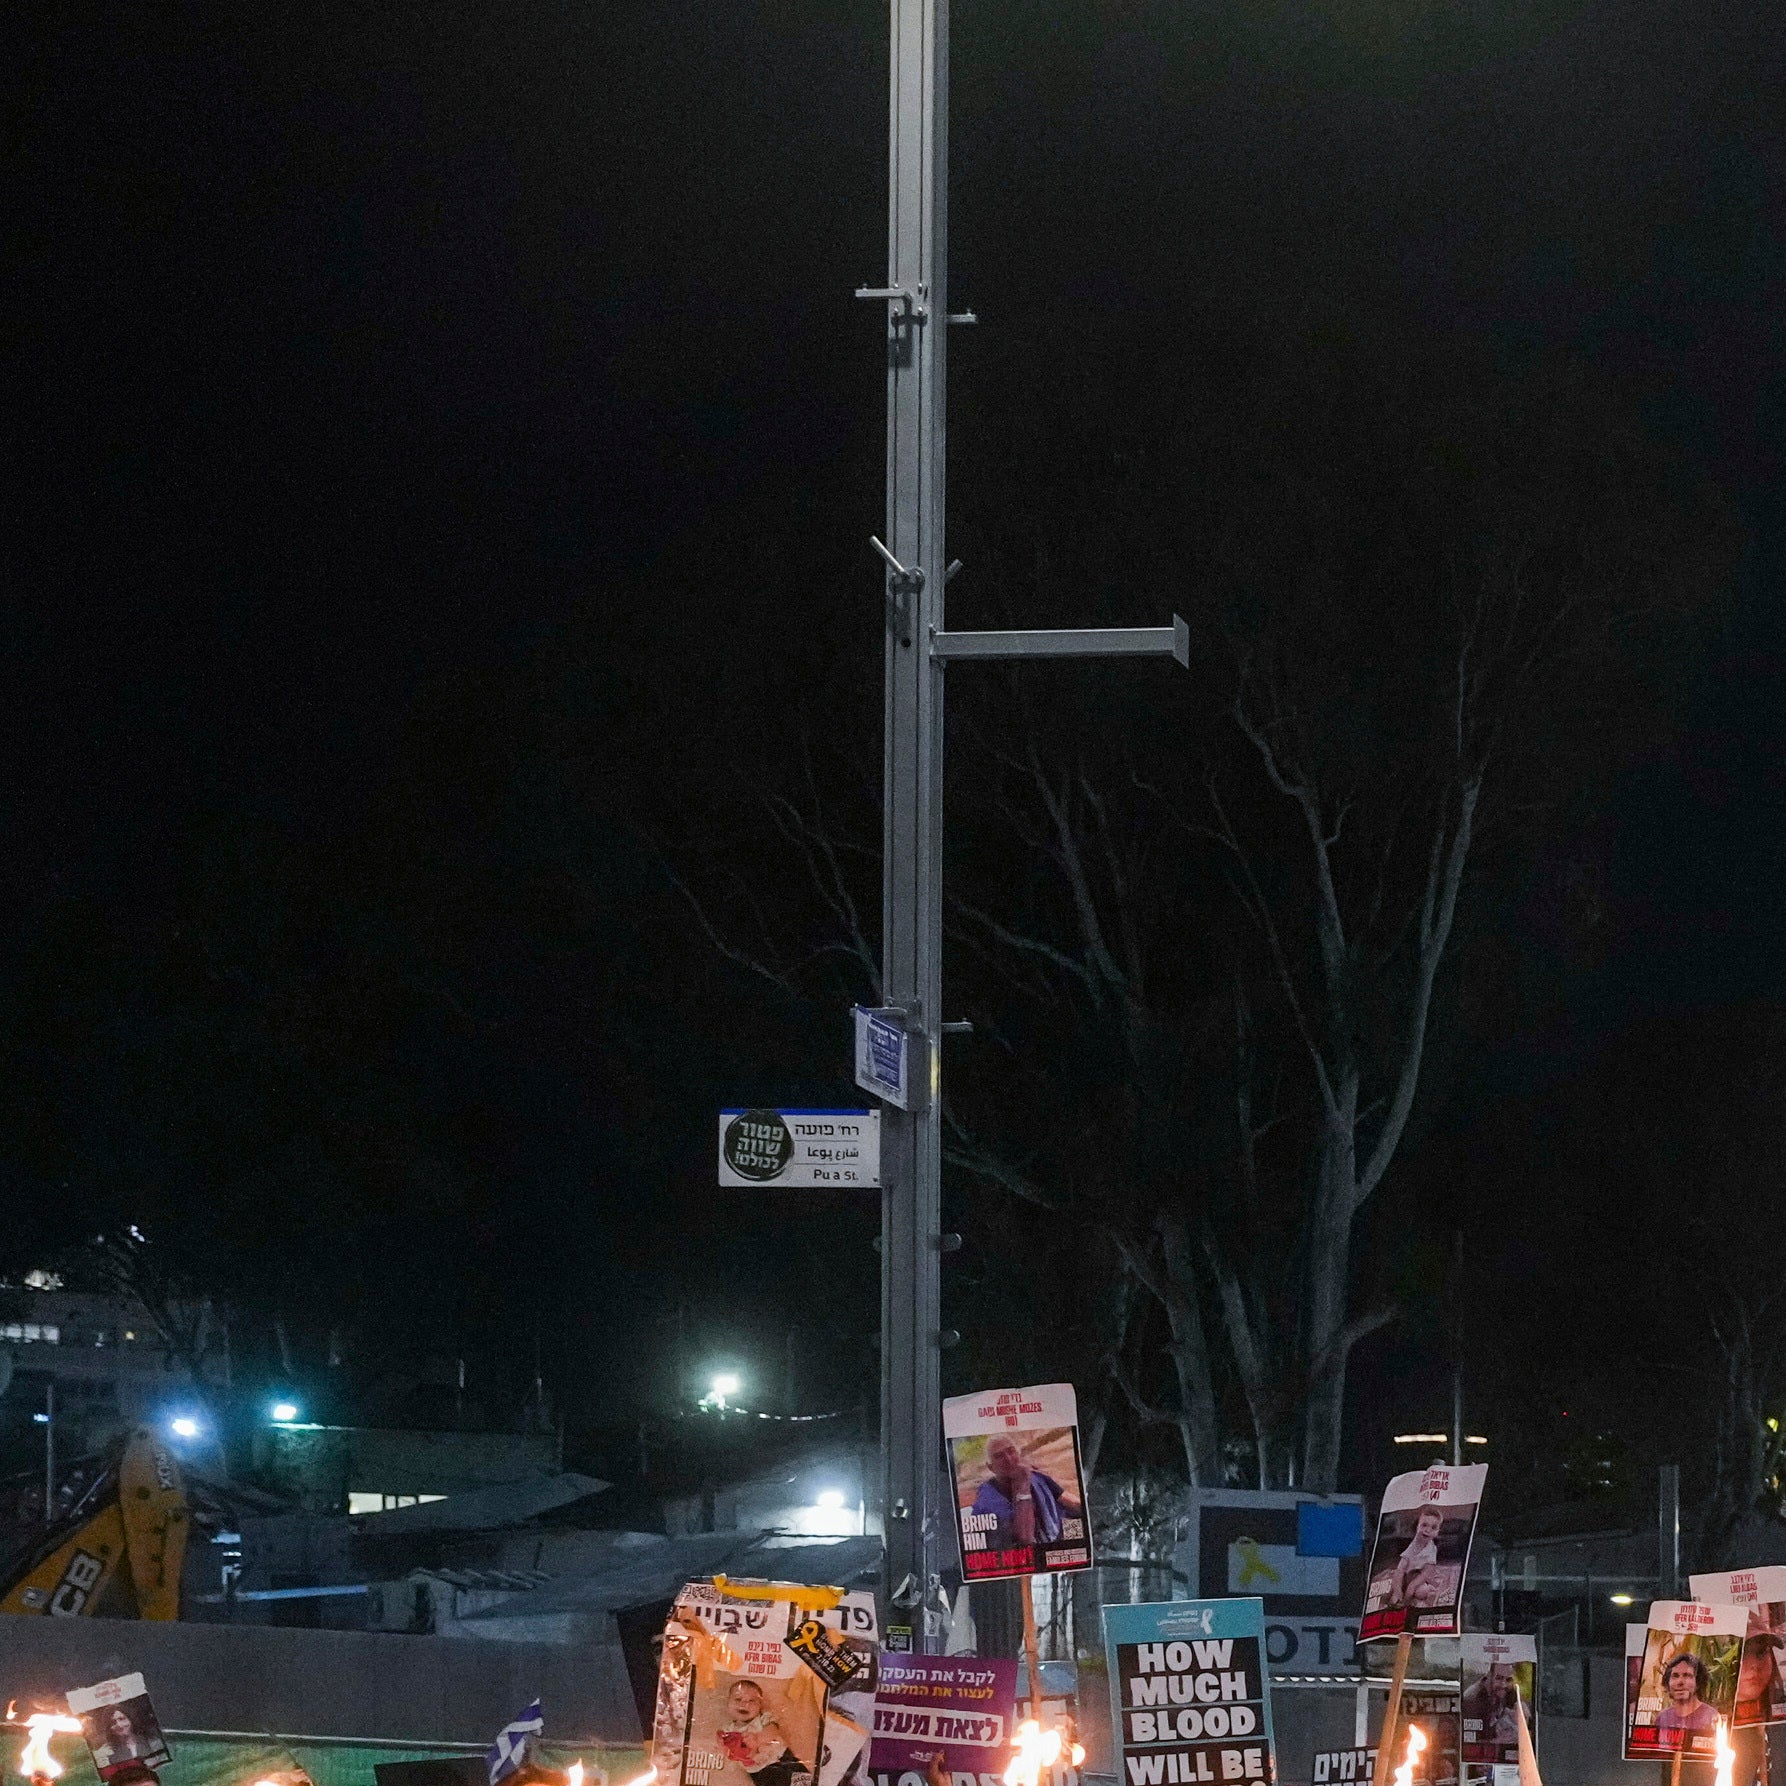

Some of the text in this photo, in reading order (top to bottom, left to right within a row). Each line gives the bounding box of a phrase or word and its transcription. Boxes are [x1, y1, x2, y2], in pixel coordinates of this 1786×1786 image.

[739, 1121, 785, 1140] פטור
[795, 1124, 835, 1137] פועה
[737, 1136, 782, 1156] שווה
[735, 1151, 780, 1170] לכולם!
[813, 1169, 830, 1181] Pu
[961, 1513, 998, 1533] BRING
[963, 1532, 988, 1550] HIM
[1137, 1639, 1235, 1674] HOW
[930, 1667, 996, 1687] לקבל את
[931, 1686, 994, 1700] לעצור את
[1130, 1671, 1248, 1707] MUCH
[1637, 1697, 1663, 1712] BRING
[1130, 1706, 1257, 1742] BLOOD
[1635, 1711, 1653, 1726] HIM
[935, 1715, 999, 1743] לצאת
[687, 1752, 725, 1770] BRING
[1126, 1748, 1265, 1786] WILL BE
[685, 1769, 710, 1786] HIM
